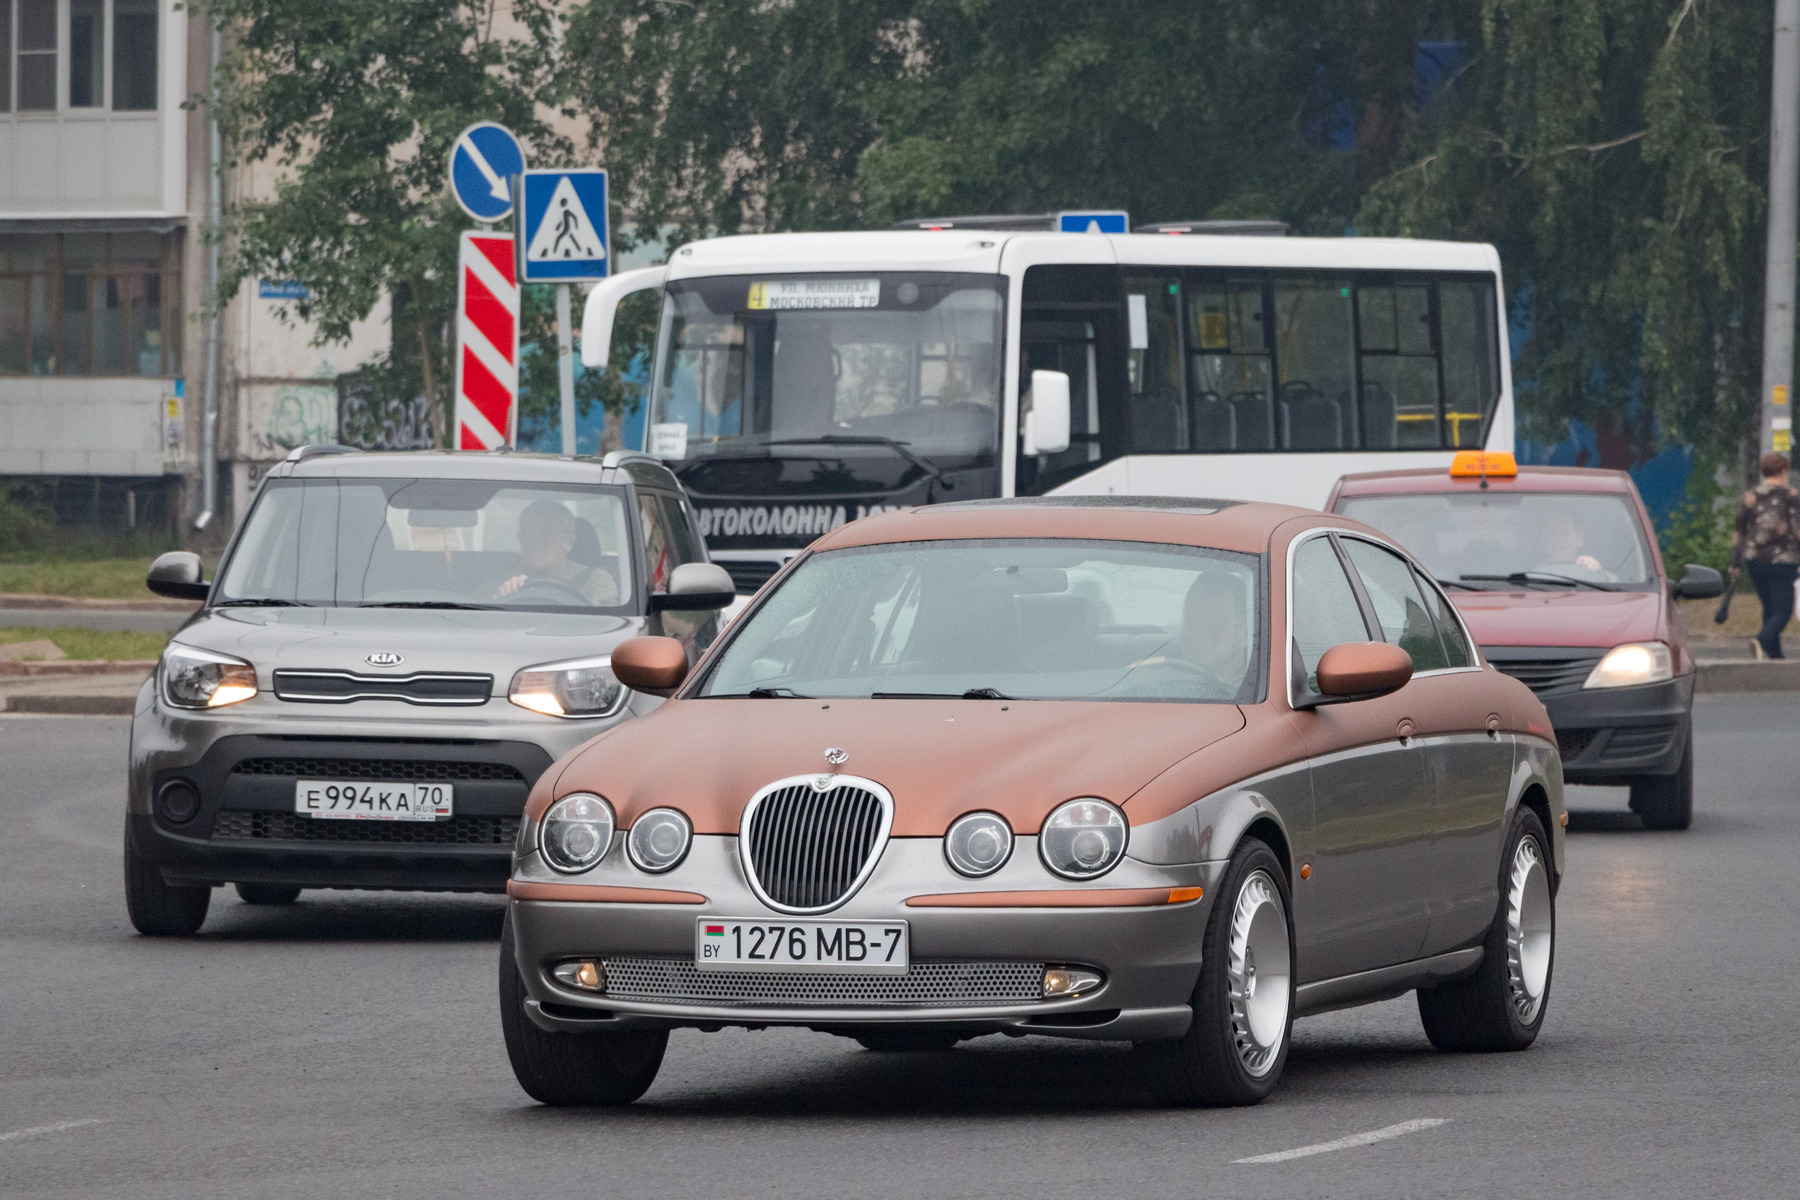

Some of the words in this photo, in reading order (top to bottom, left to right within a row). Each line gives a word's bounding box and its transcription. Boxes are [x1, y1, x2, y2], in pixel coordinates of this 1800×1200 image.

[770, 294, 855, 308] МОСКОВСКИЙ
[370, 653, 398, 663] KIA
[418, 786, 443, 805] 70
[416, 805, 435, 813] RUS
[732, 925, 807, 960] 1276
[704, 944, 721, 958] BY
